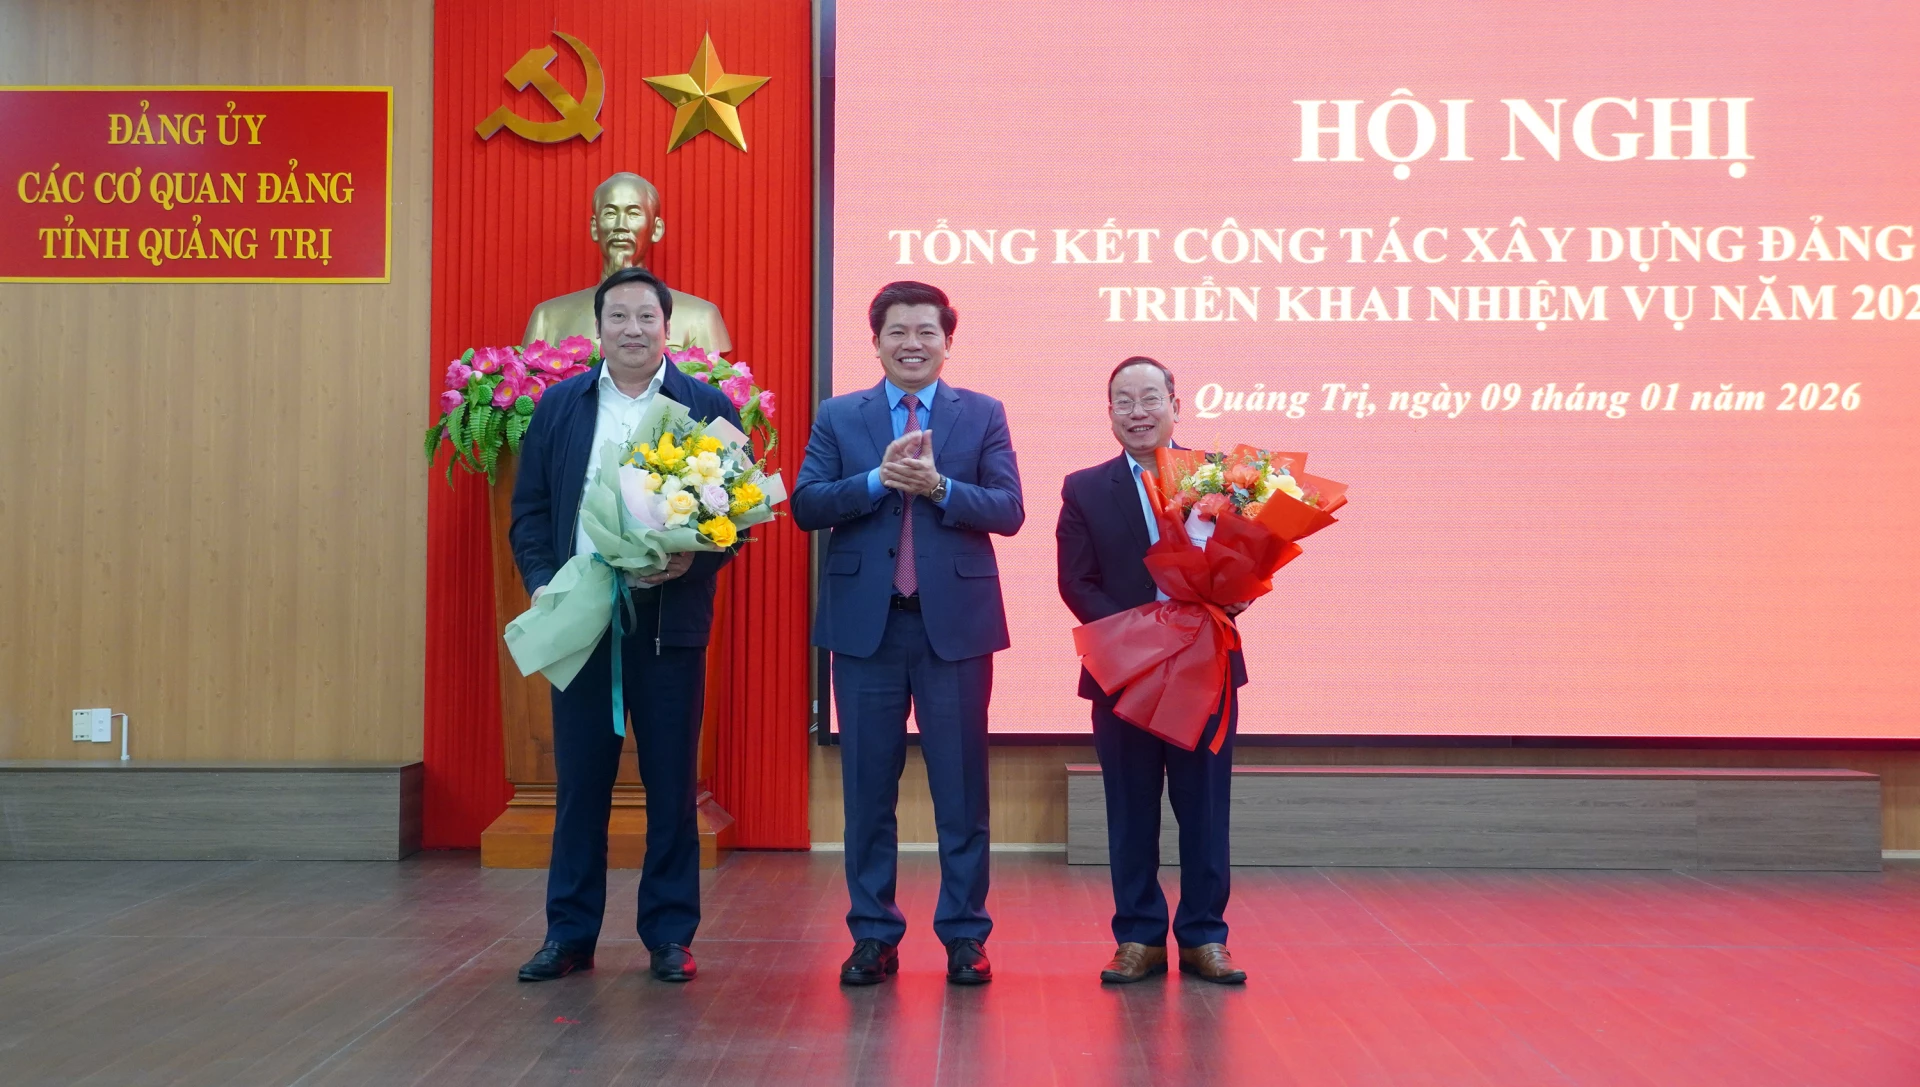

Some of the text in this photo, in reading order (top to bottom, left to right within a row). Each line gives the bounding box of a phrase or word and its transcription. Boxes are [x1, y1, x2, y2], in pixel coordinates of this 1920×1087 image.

[108, 100, 266, 145] ĐẢNG ỦY
[1293, 88, 1755, 180] HỘI NGHỊ
[17, 158, 355, 211] CÁC CƠ QUAN ĐẢNG
[39, 214, 333, 266] TỈNH QUẢNG TRỊ
[888, 215, 1915, 272] TỔNG KẾT CÔNG TÁC XÂY DỰNG ĐẢNG
[1099, 276, 1260, 322] TRIỂN
[1276, 286, 1412, 322] KHAI
[1427, 280, 1608, 331] NHIỆM
[1622, 286, 1697, 331] VỤ
[1711, 275, 1837, 321] NĂM
[1195, 383, 1862, 419] Quảng Trị, ngày 09 tháng 01 năm 2026
